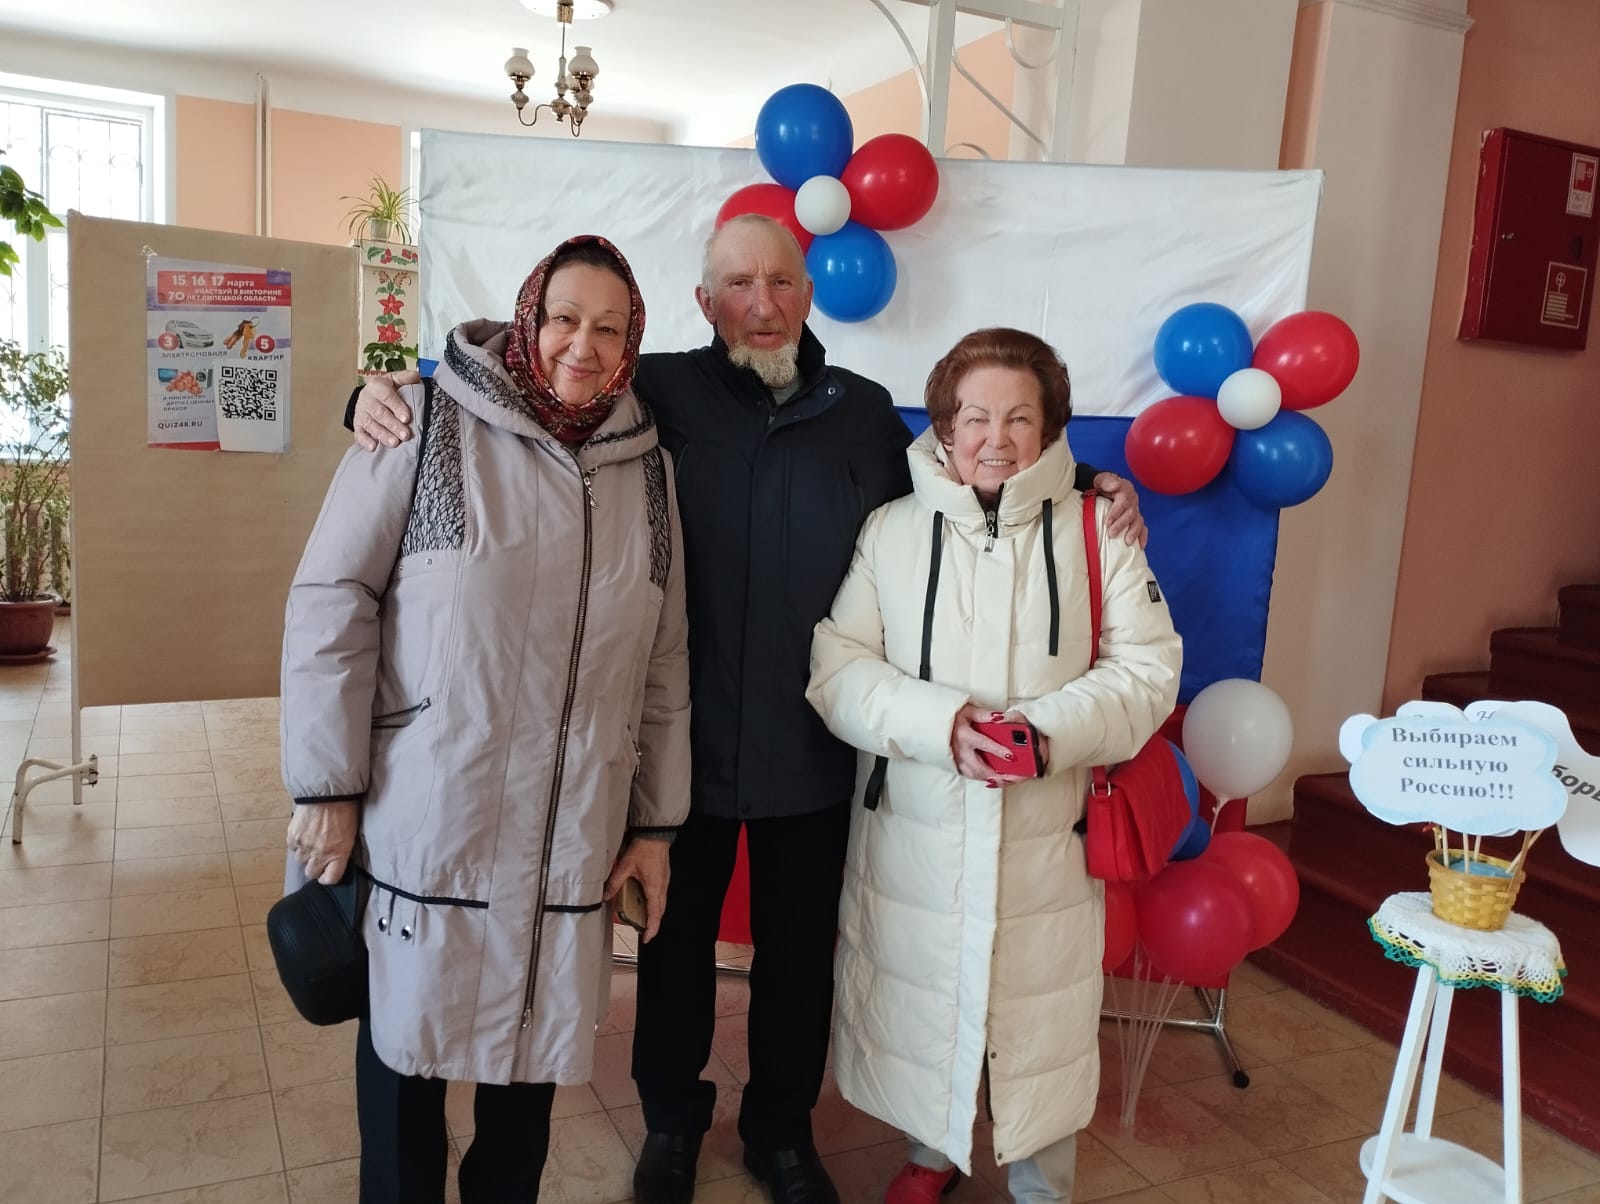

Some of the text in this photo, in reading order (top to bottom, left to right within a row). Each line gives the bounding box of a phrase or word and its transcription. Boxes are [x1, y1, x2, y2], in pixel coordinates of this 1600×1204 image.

[211, 275, 225, 287] 17
[227, 280, 255, 288] марта
[168, 291, 185, 300] 70
[201, 294, 242, 302] ЛИПЕЦКОЙ
[194, 287, 232, 295] УЧАСТВУЙ
[163, 335, 172, 348] 3
[260, 338, 270, 350] 5
[157, 420, 203, 430] QUIZ48.RU
[1391, 727, 1518, 748] Выбираем
[1402, 754, 1509, 775] сильную
[1400, 777, 1514, 800] Россию!!!
